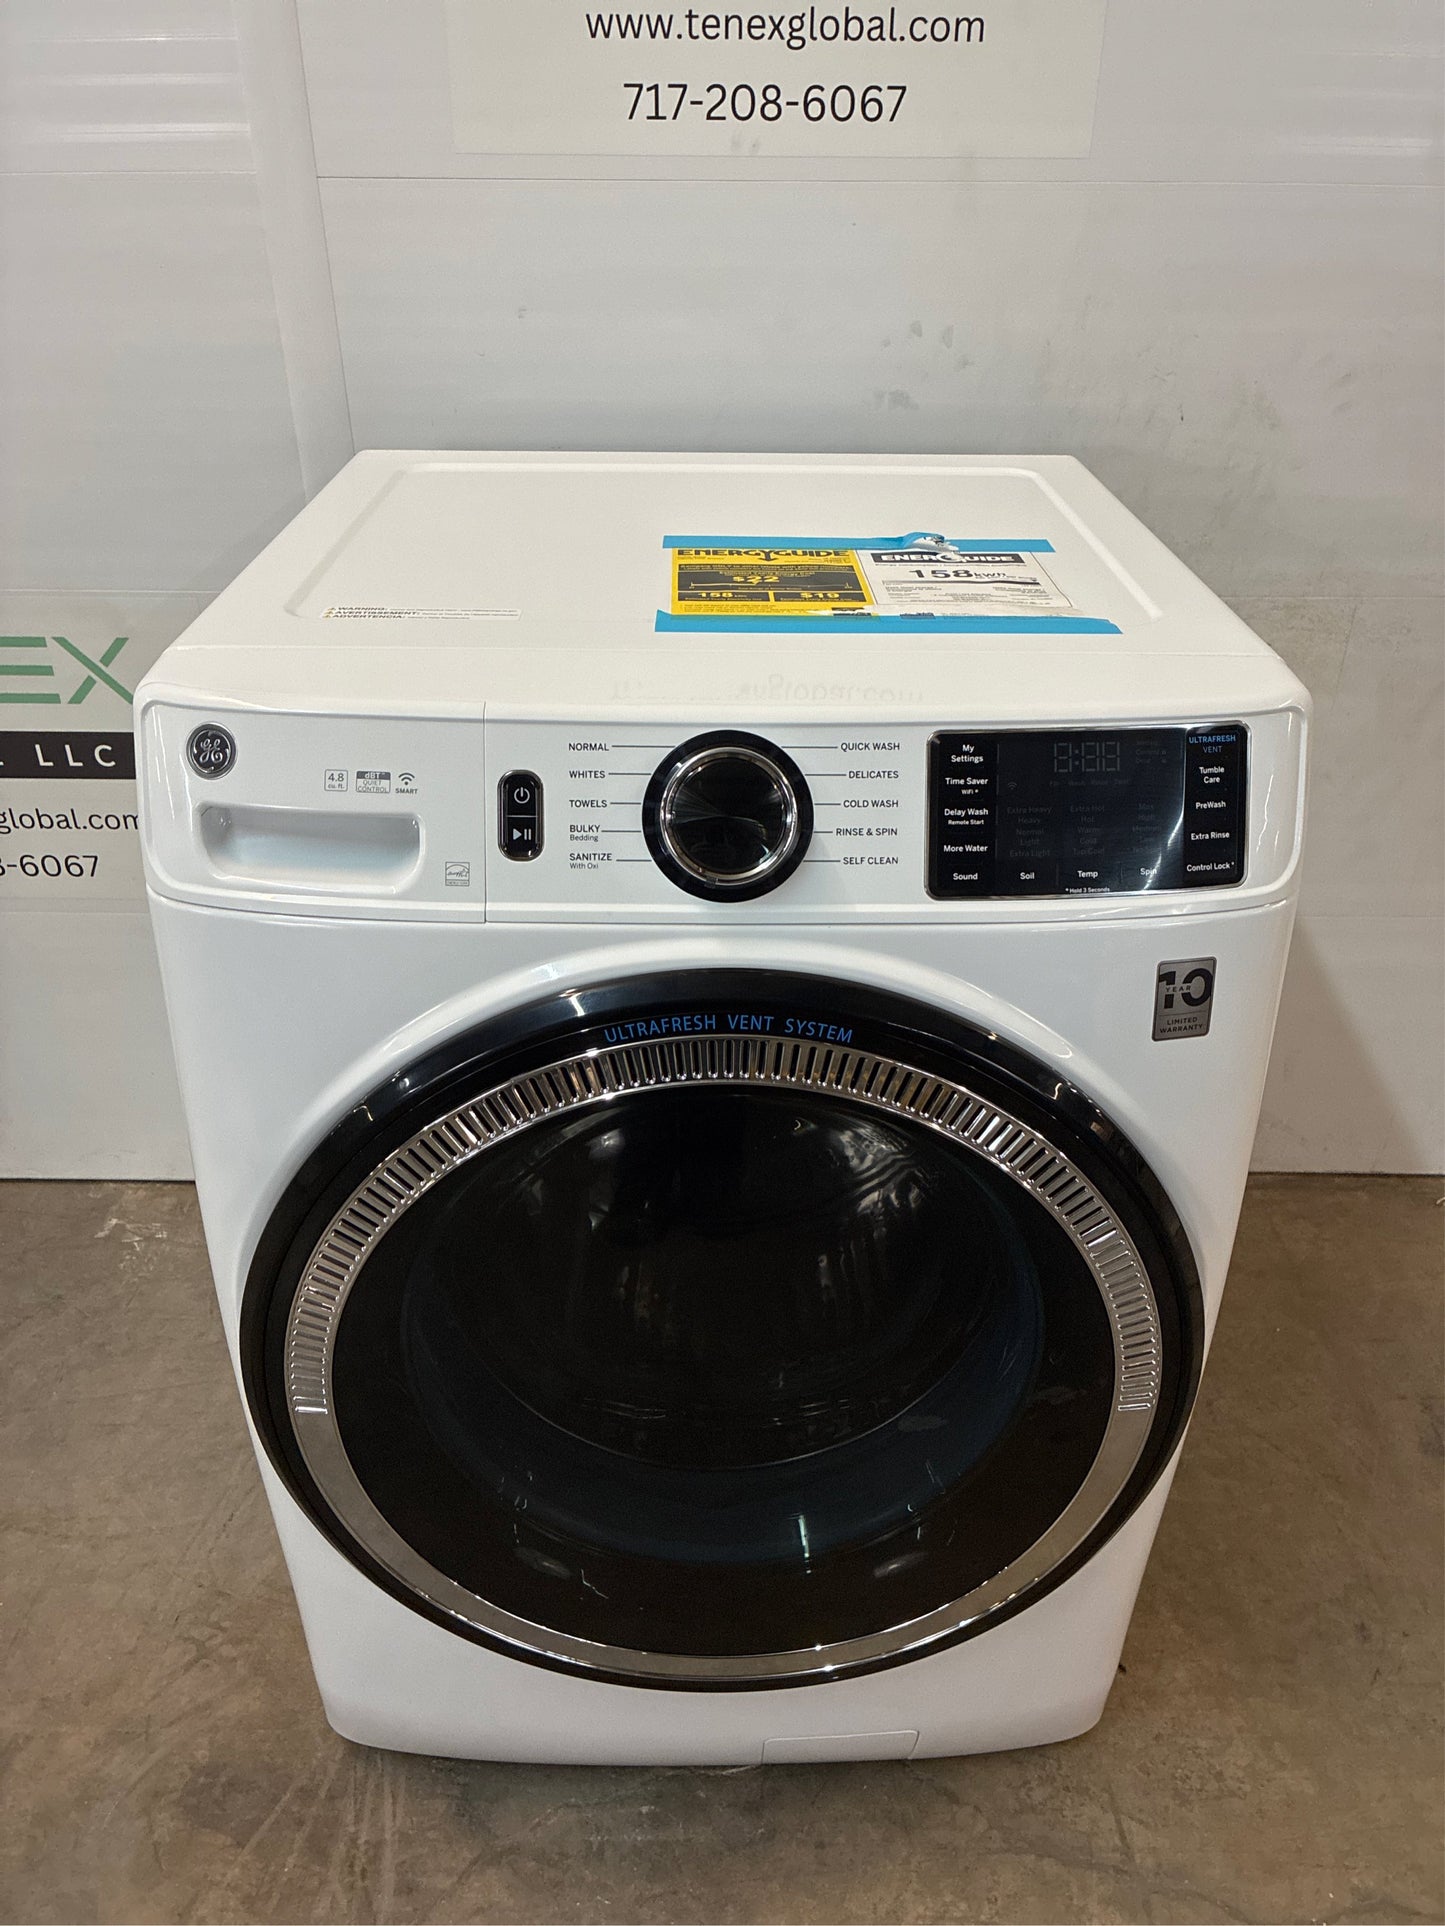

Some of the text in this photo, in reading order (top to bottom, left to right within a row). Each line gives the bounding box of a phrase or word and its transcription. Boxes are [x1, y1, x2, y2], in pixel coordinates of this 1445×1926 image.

[586, 6, 985, 51] www.tenexglobal.com
[623, 83, 907, 122] 717-208-6067
[909, 570, 973, 578] 158
[1189, 735, 1236, 744] ULTRAFRESH
[568, 743, 610, 751] NORMAL
[840, 743, 900, 752] QUICK WASH
[962, 744, 975, 753] My
[35, 744, 116, 767] LLC
[951, 755, 984, 764] Settings
[569, 770, 606, 779] WHITES
[1199, 766, 1225, 774] Tumble
[328, 772, 345, 783] 4.8
[848, 771, 899, 779] DELICATES
[945, 777, 988, 785] Time Saver
[1203, 776, 1221, 784] Care
[569, 799, 608, 808] TOWELS
[843, 800, 899, 808] COLD WASH
[1195, 800, 1226, 809] PreWash
[944, 808, 989, 817] Delay Wash
[569, 824, 600, 833] BULKY
[836, 828, 898, 836] RINSE & SPIN
[569, 833, 599, 842] Bedding
[1210, 831, 1230, 839] Rinse
[569, 853, 612, 861] SANITIZE
[843, 857, 898, 865] SELF CLEAN
[569, 862, 586, 870] With
[1187, 862, 1213, 872] Control
[953, 872, 978, 880] Sound
[1020, 872, 1035, 880] Soil
[1077, 870, 1099, 878] Temp
[1140, 867, 1157, 876] Spin
[1158, 967, 1213, 1009] 10
[1165, 985, 1191, 993] YEAR
[1167, 1016, 1198, 1026] LIMITED
[604, 1014, 854, 1044] ULTRAFRESH VENT SYSTEM
[1160, 1024, 1203, 1034] WARRANTY
